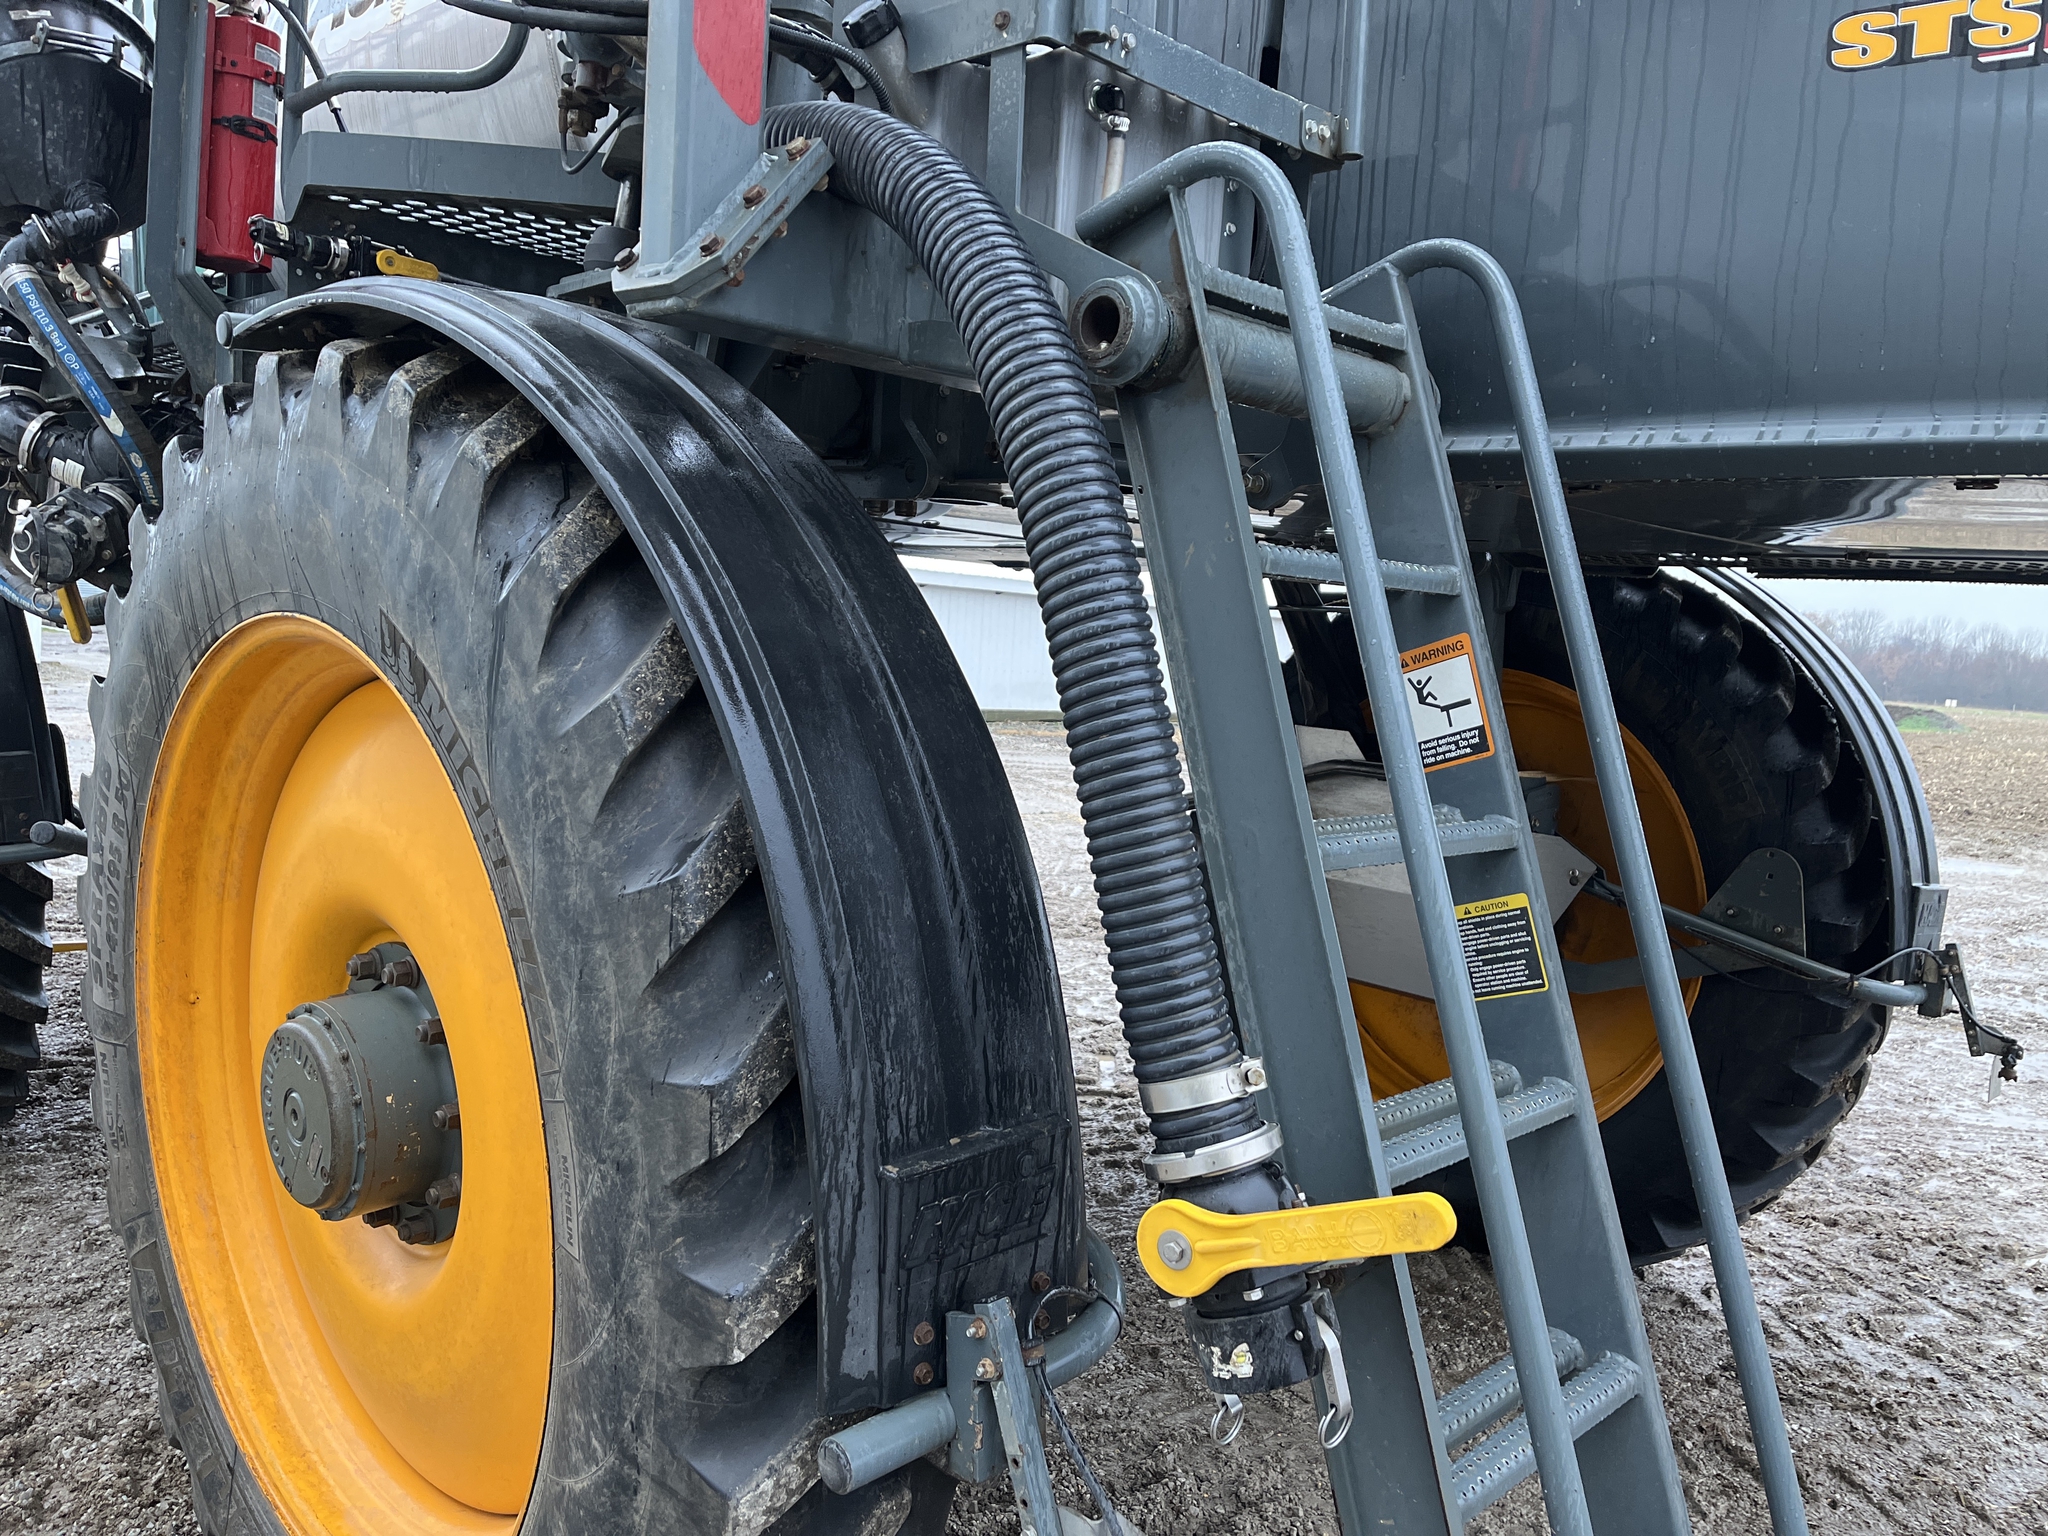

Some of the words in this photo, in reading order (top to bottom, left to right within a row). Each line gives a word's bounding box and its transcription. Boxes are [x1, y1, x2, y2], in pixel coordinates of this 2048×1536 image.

[1832, 0, 2042, 68] STS
[26, 294, 40, 309] PSI
[139, 470, 156, 498] Water
[1410, 639, 1464, 665] WARNING
[1419, 739, 1437, 749] Avoid
[1437, 733, 1460, 745] serious
[1460, 728, 1479, 740] injury
[1421, 747, 1436, 756] from
[1436, 741, 1457, 754] falling.
[1458, 738, 1468, 746] Do
[1468, 736, 1479, 744] not
[1423, 755, 1436, 764] ride
[1444, 745, 1472, 758] machine.
[111, 812, 126, 838] R
[421, 682, 558, 1071] MICHELIN
[1473, 900, 1509, 912] CAUTION
[561, 1154, 574, 1247] MICHELIN
[1268, 1209, 1386, 1254] BANJO
